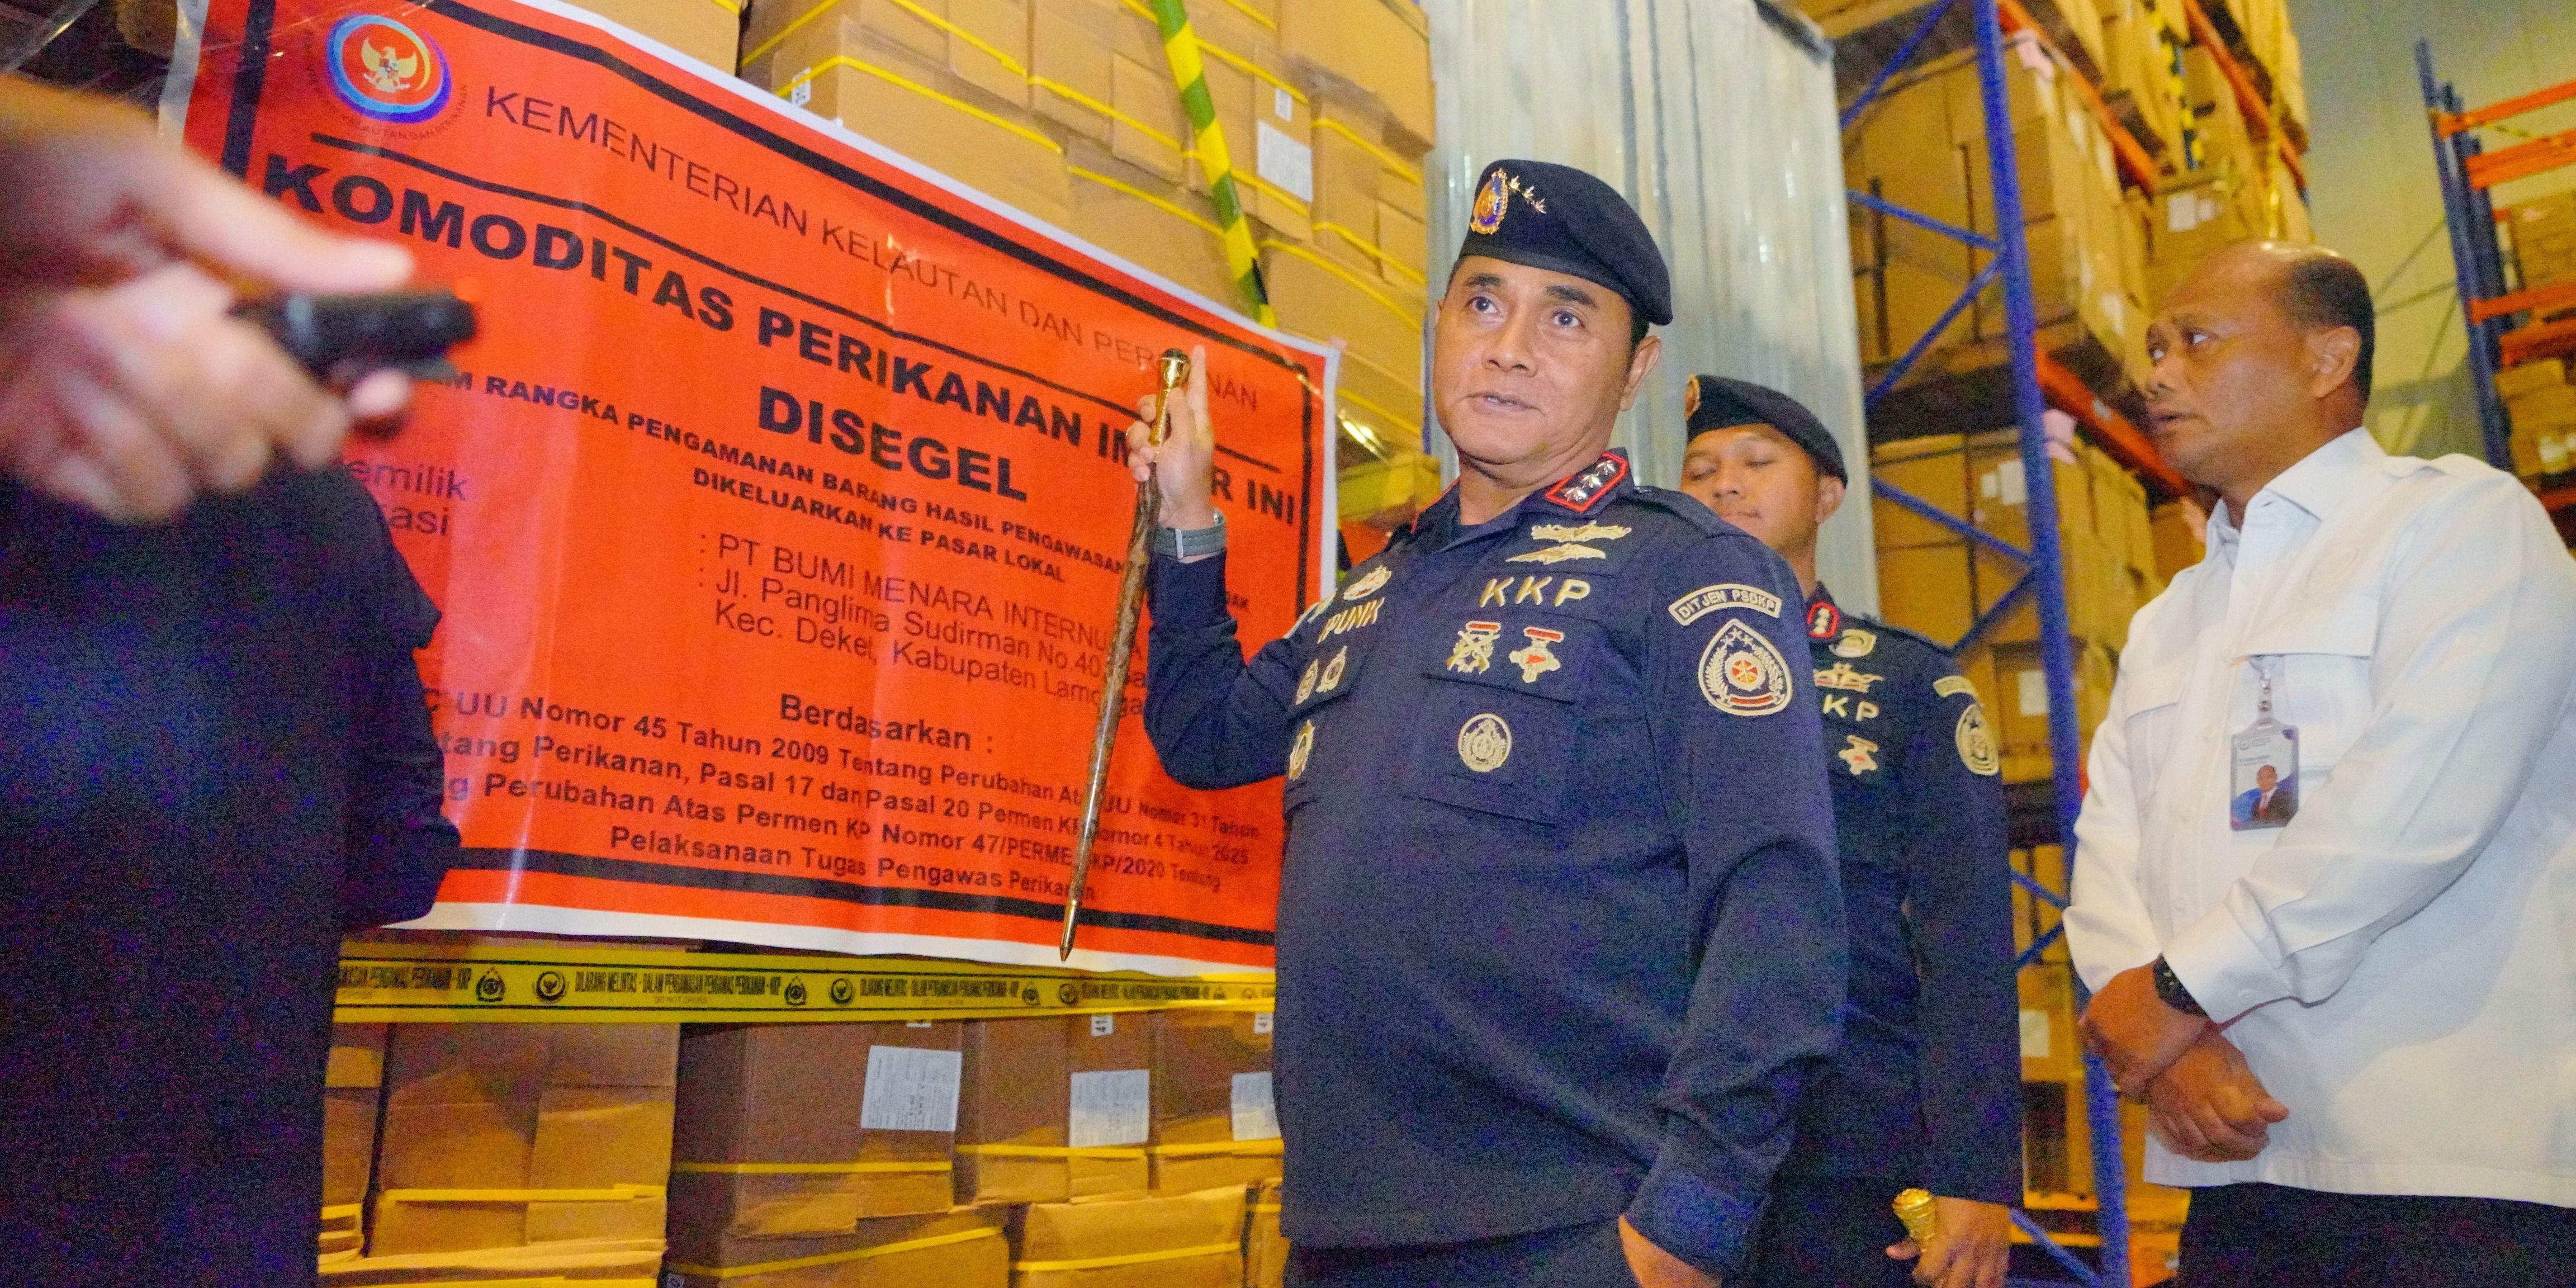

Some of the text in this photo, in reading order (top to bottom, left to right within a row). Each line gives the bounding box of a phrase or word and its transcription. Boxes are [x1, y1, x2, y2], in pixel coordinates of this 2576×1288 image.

[486, 85, 807, 236] KEMENTERIAN
[823, 218, 1007, 316] KELAUTAN
[1019, 300, 1083, 346] DAN
[1094, 330, 1257, 411] PERNAN
[263, 153, 734, 332] KOMODITAS
[757, 306, 1081, 447] PERIKANAN
[1247, 479, 1294, 525] INI
[486, 376, 618, 425] RANGKA
[628, 412, 814, 484] PENGAMANAN
[823, 472, 917, 514] BARANG
[926, 501, 993, 533] HASIL
[1001, 520, 1124, 575] PENGAWASAN
[759, 386, 1027, 501] DISEGEL
[347, 460, 468, 501] emilik
[719, 533, 761, 566] PT
[774, 546, 854, 589] BUMI
[864, 569, 993, 621] MENARA
[1005, 600, 1142, 661] INTERNUA
[694, 467, 1066, 583] DIKELUARKAN KE PASAR LOKAL
[761, 577, 890, 633] Panglima
[903, 610, 1030, 660] Sudirman
[1479, 576, 1590, 608] KKP
[1677, 589, 1775, 619] DITJEN PSDKP
[716, 599, 783, 638] Kec.
[893, 640, 1035, 689] Kabupaten
[457, 692, 508, 718] UU
[520, 697, 627, 733] Nomor
[634, 715, 667, 739] 45
[678, 722, 762, 755] Tahun
[771, 737, 829, 765] 2009
[840, 748, 932, 785] Tentang
[941, 764, 1053, 801] Perubahan
[781, 694, 972, 751] Berdasarkan
[484, 773, 654, 813] Perubahan
[662, 794, 726, 823] Atas
[736, 803, 837, 836] Permen
[845, 817, 871, 839] KP
[881, 823, 964, 852] Nomor
[534, 736, 690, 785] Perikanan,
[700, 761, 774, 792] Pasal
[785, 775, 814, 796] 17
[821, 782, 862, 804] dan
[865, 788, 935, 815] Pasal
[943, 798, 969, 818] 20
[978, 801, 1053, 832] Permen
[610, 825, 792, 866] Pelaksanaan
[802, 847, 866, 877] Tugas
[877, 857, 1002, 886] Pengawas
